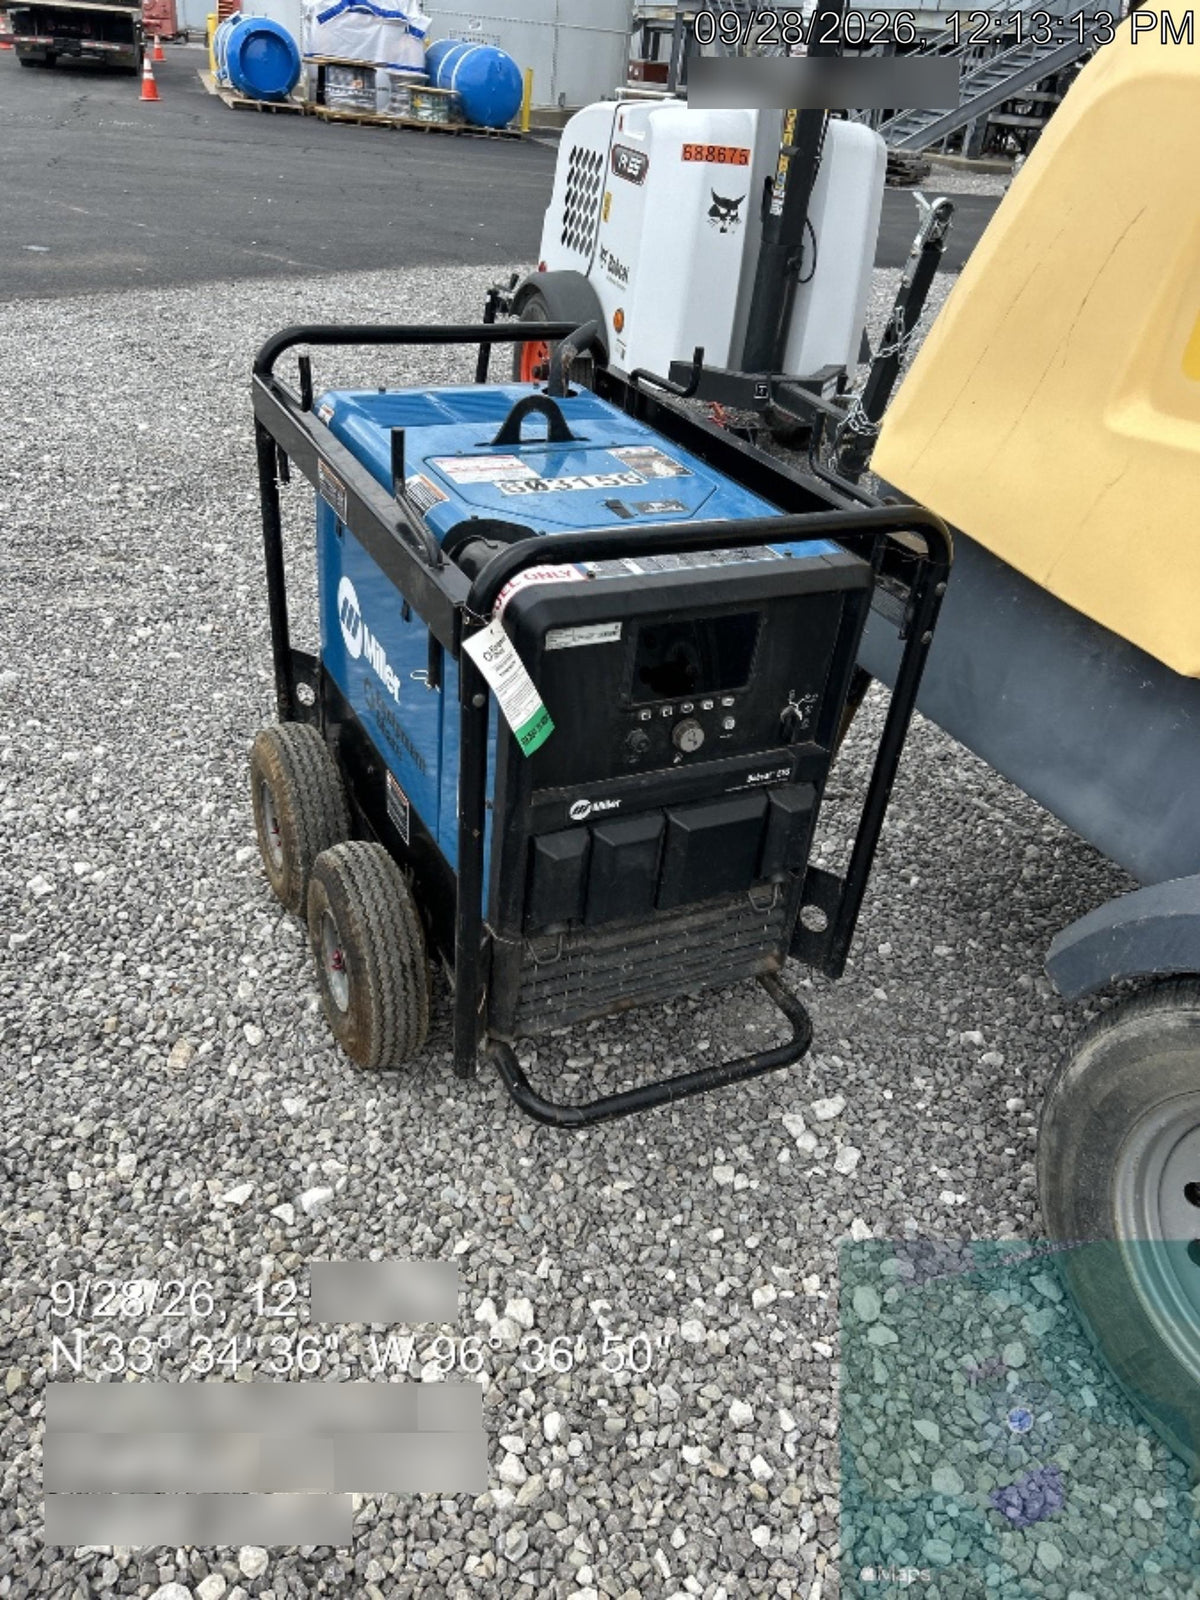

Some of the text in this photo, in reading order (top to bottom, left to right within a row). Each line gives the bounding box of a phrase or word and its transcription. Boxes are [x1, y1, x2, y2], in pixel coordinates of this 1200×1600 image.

[683, 144, 749, 166] 688675
[523, 569, 572, 581] ONLY
[363, 623, 401, 704] Miller
